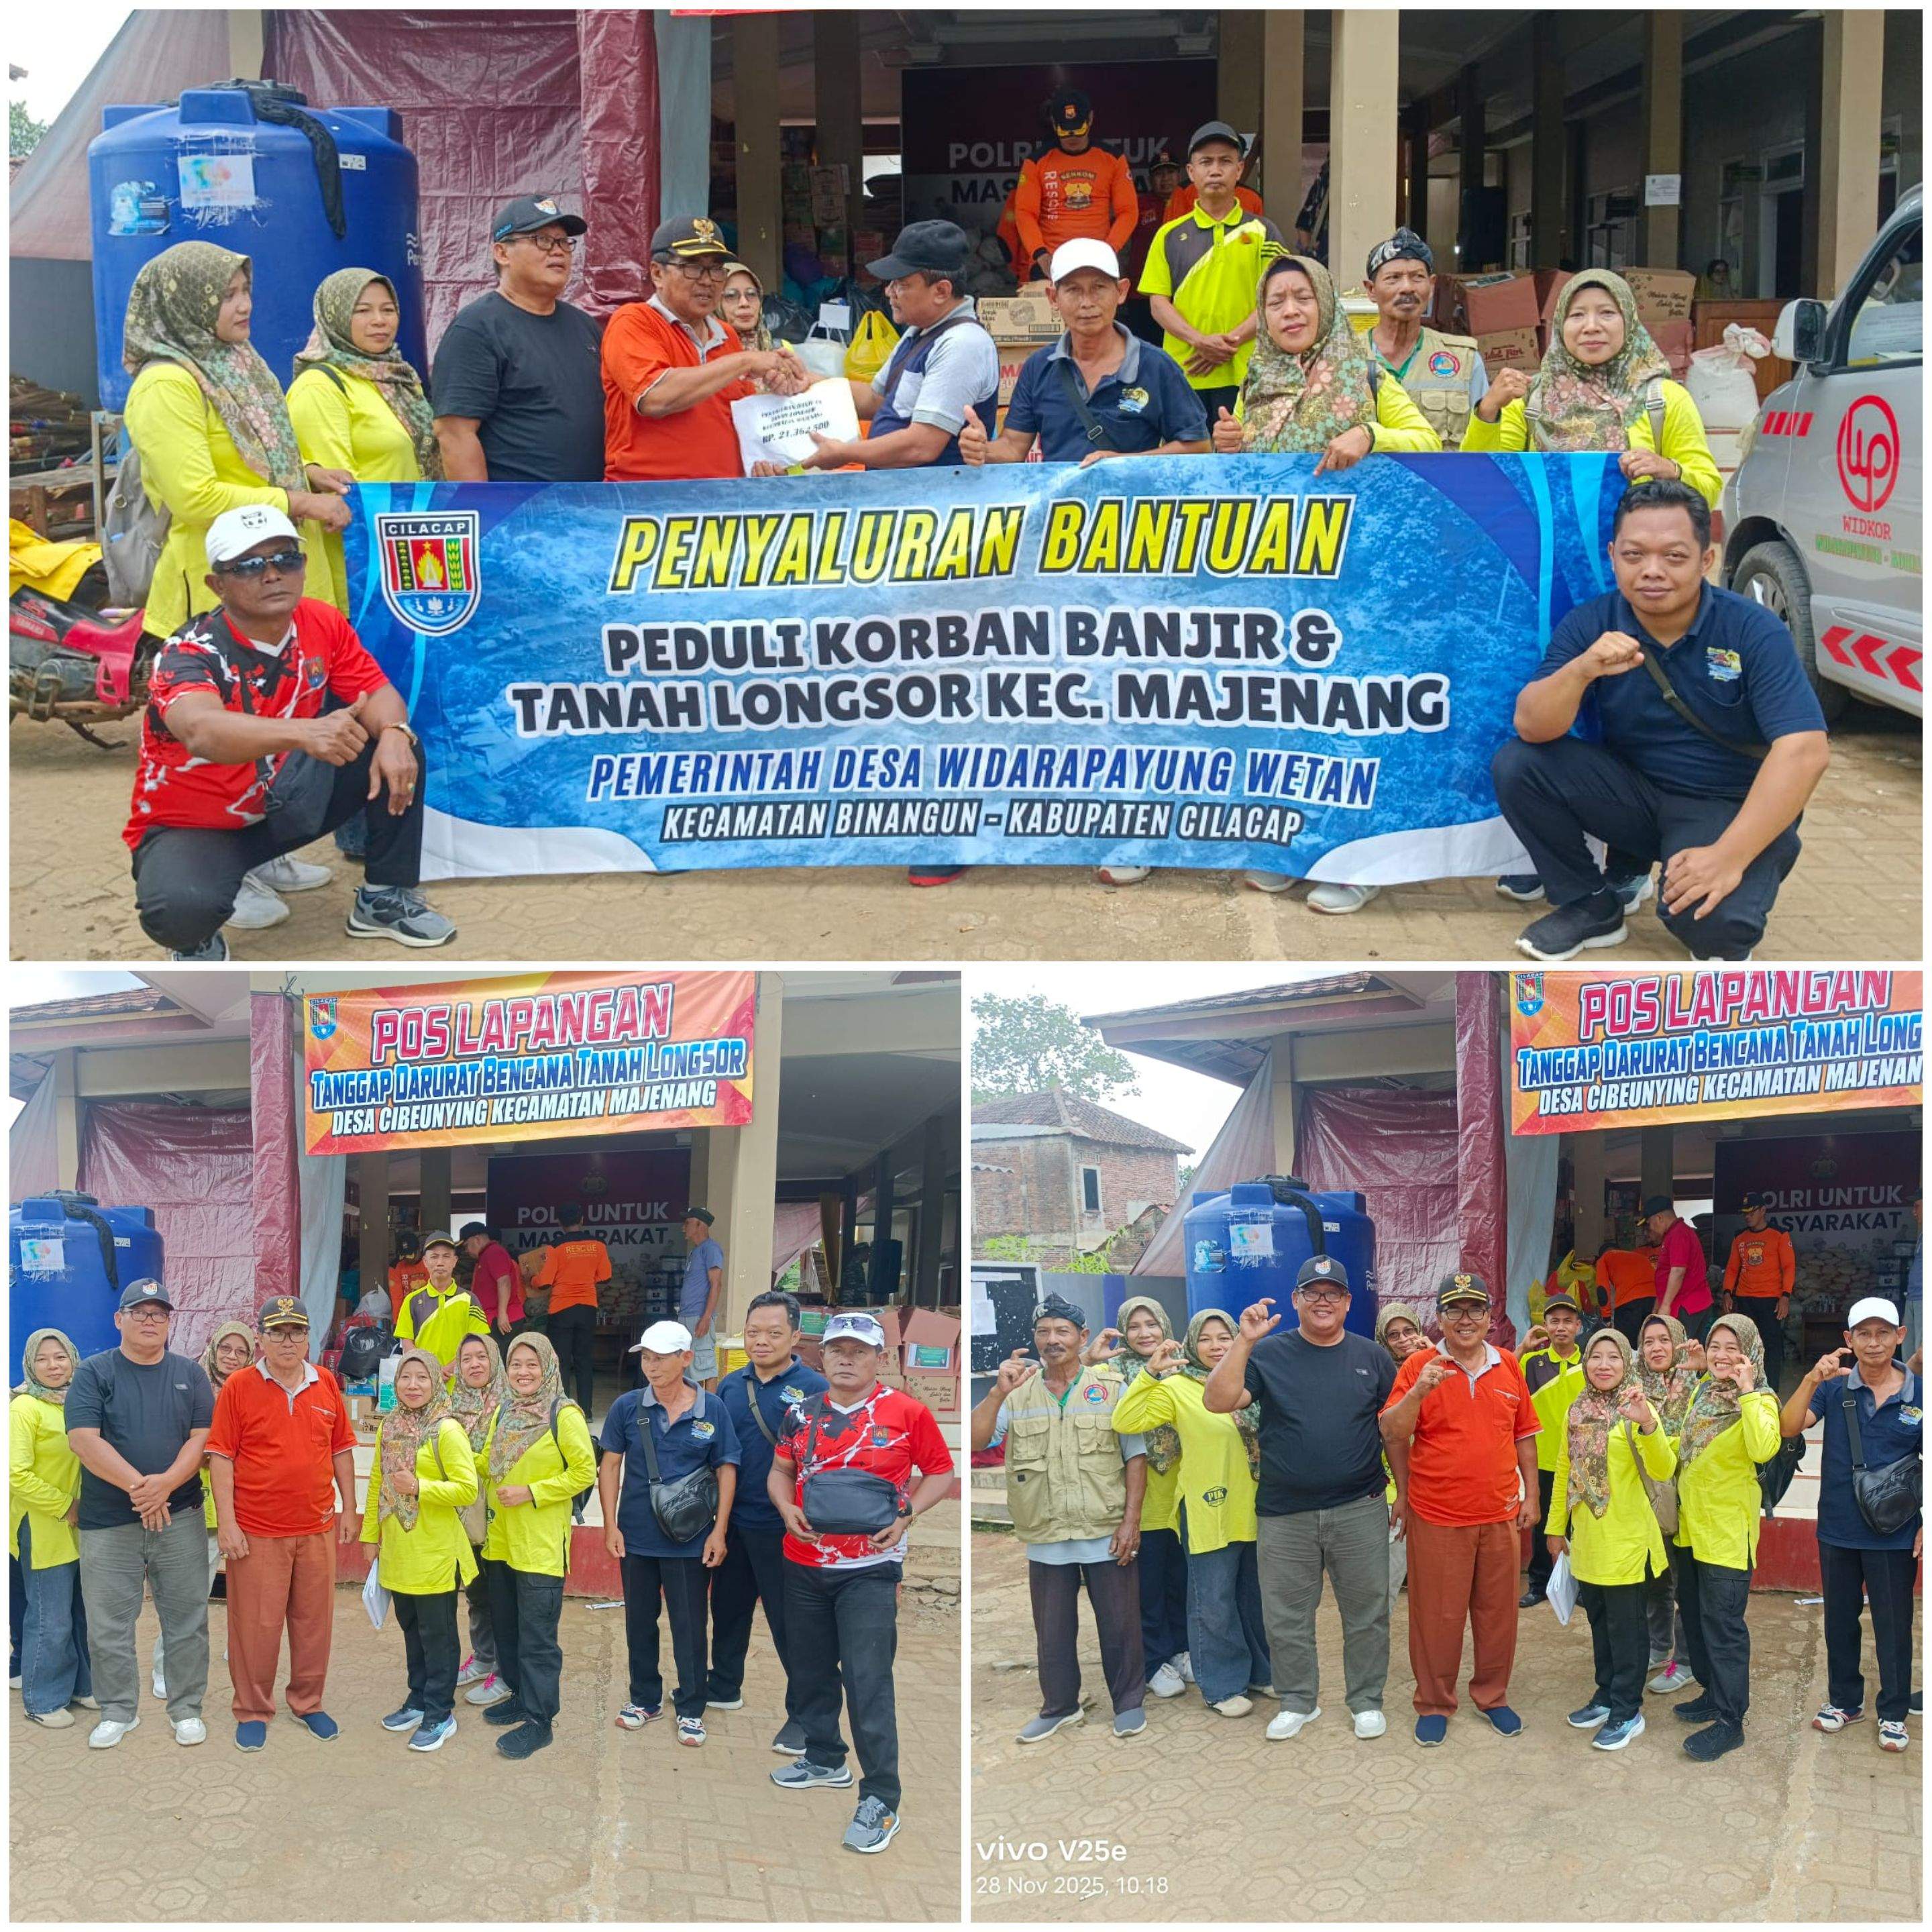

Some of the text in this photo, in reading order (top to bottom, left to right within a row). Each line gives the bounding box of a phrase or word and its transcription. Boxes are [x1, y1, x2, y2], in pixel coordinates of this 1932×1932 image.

[949, 140, 1042, 168] POLR
[388, 523, 466, 535] CILACAP
[609, 497, 1354, 592] PENYALURAN BANTUAN
[1843, 516, 1892, 541] WIDKOR
[607, 610, 1336, 672] PEDULI KORBAN BANJIR &
[513, 673, 1444, 733] TANAH LONGSOR KEC. MAJENANG
[590, 747, 1378, 807] PEMERINTAH DESA WIDARAPAYUNG WETAN
[662, 802, 828, 843] KECAMATAN
[834, 800, 979, 837] BINANGUN
[1008, 802, 1170, 839] KABUPATEN
[1179, 805, 1302, 845] CILACAP
[372, 983, 673, 1063] POS LAPANGAN
[1580, 971, 1890, 1039] POS LAPANGAN
[311, 1038, 747, 1110] TANGGAP DARURAT BENCANA TANAH LONGSOR
[1517, 1046, 1601, 1089] TANGGAP
[1601, 1037, 1692, 1081] DARURAT
[1692, 1026, 1788, 1072] BENCANA
[1791, 1018, 1863, 1063] TANAH
[332, 1080, 717, 1136] DESA CIBEUNYING KECAMATAN MAJENANG
[1538, 1088, 1583, 1115] DESA
[1587, 1075, 1699, 1112] CIBEUNYING
[1703, 1064, 1823, 1101] KECAMATAN
[517, 1201, 669, 1226] POL UNTUK
[1746, 1185, 1903, 1209] OLRI UNTUK
[1764, 1211, 1902, 1233] ASYARAKAT
[519, 1227, 668, 1249] MASRAKAT
[566, 1244, 596, 1253] RESCUE
